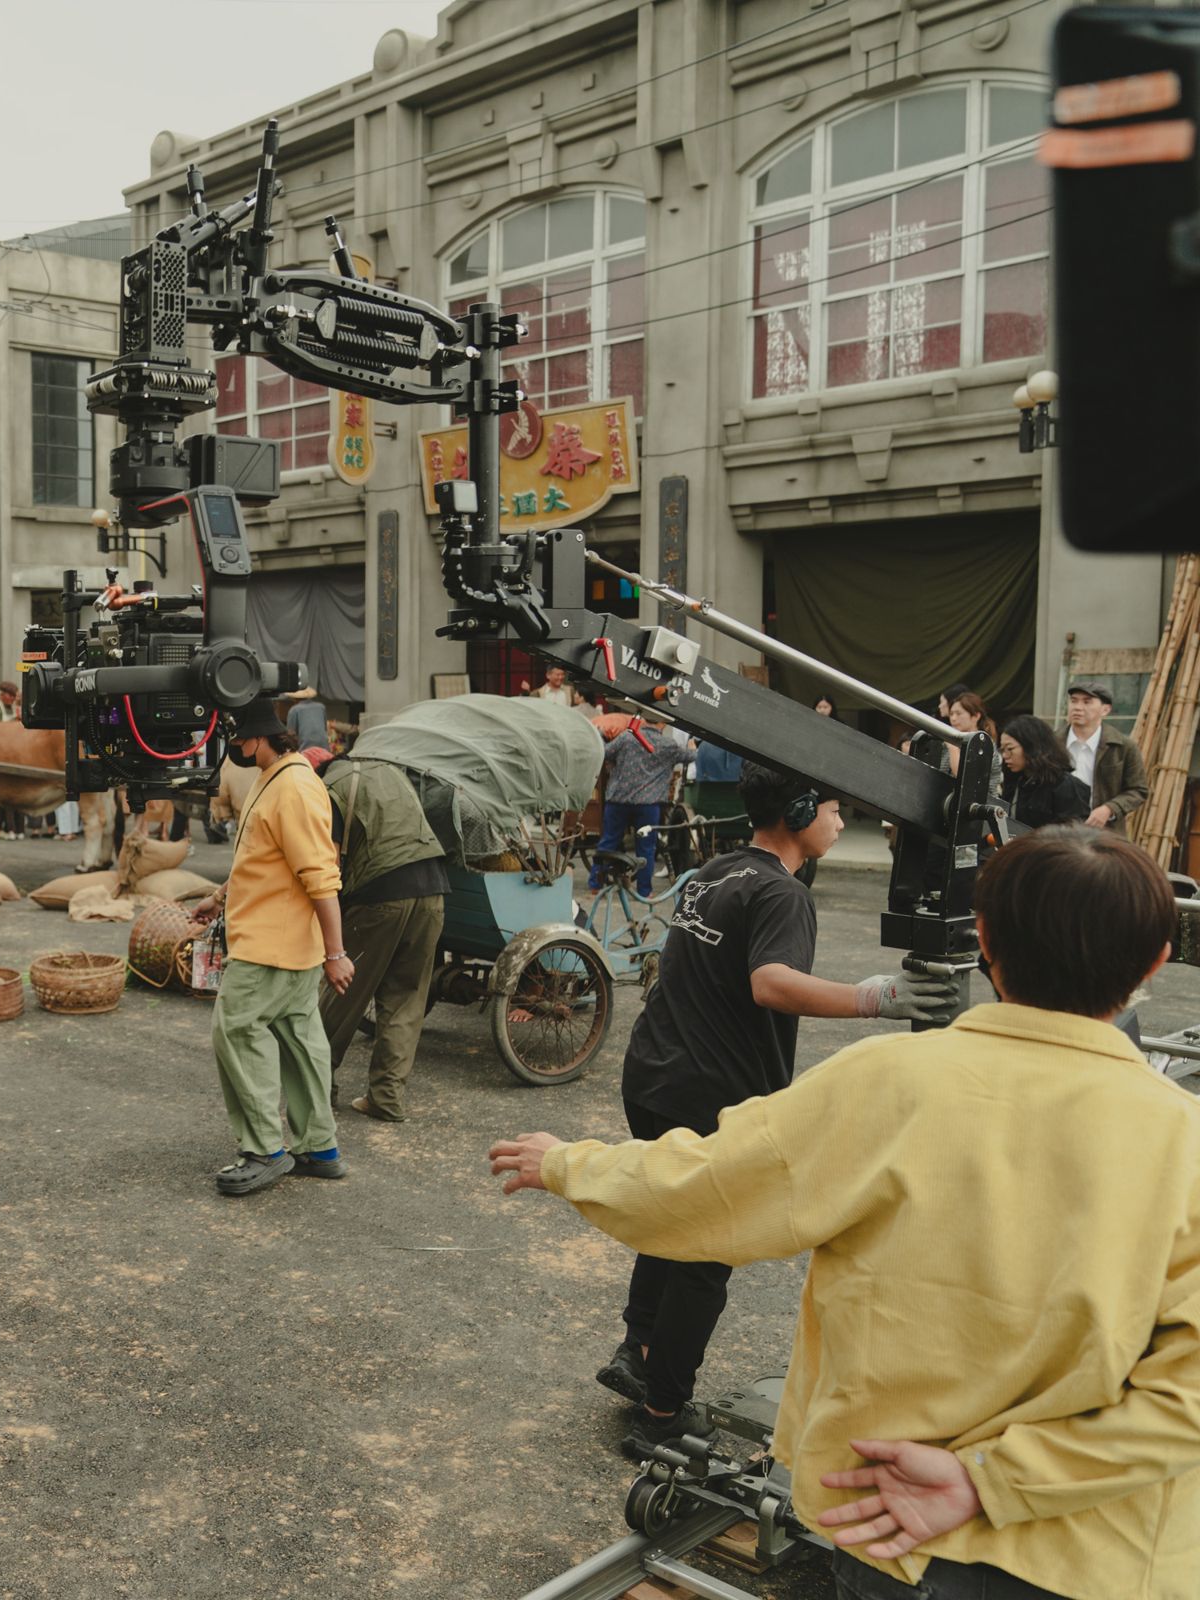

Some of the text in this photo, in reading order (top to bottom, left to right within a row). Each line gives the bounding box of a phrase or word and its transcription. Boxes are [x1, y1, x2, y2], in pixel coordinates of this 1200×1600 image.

[621, 645, 661, 680] VARIO
[74, 674, 96, 693] RONIN
[693, 690, 720, 708] PANTHER
